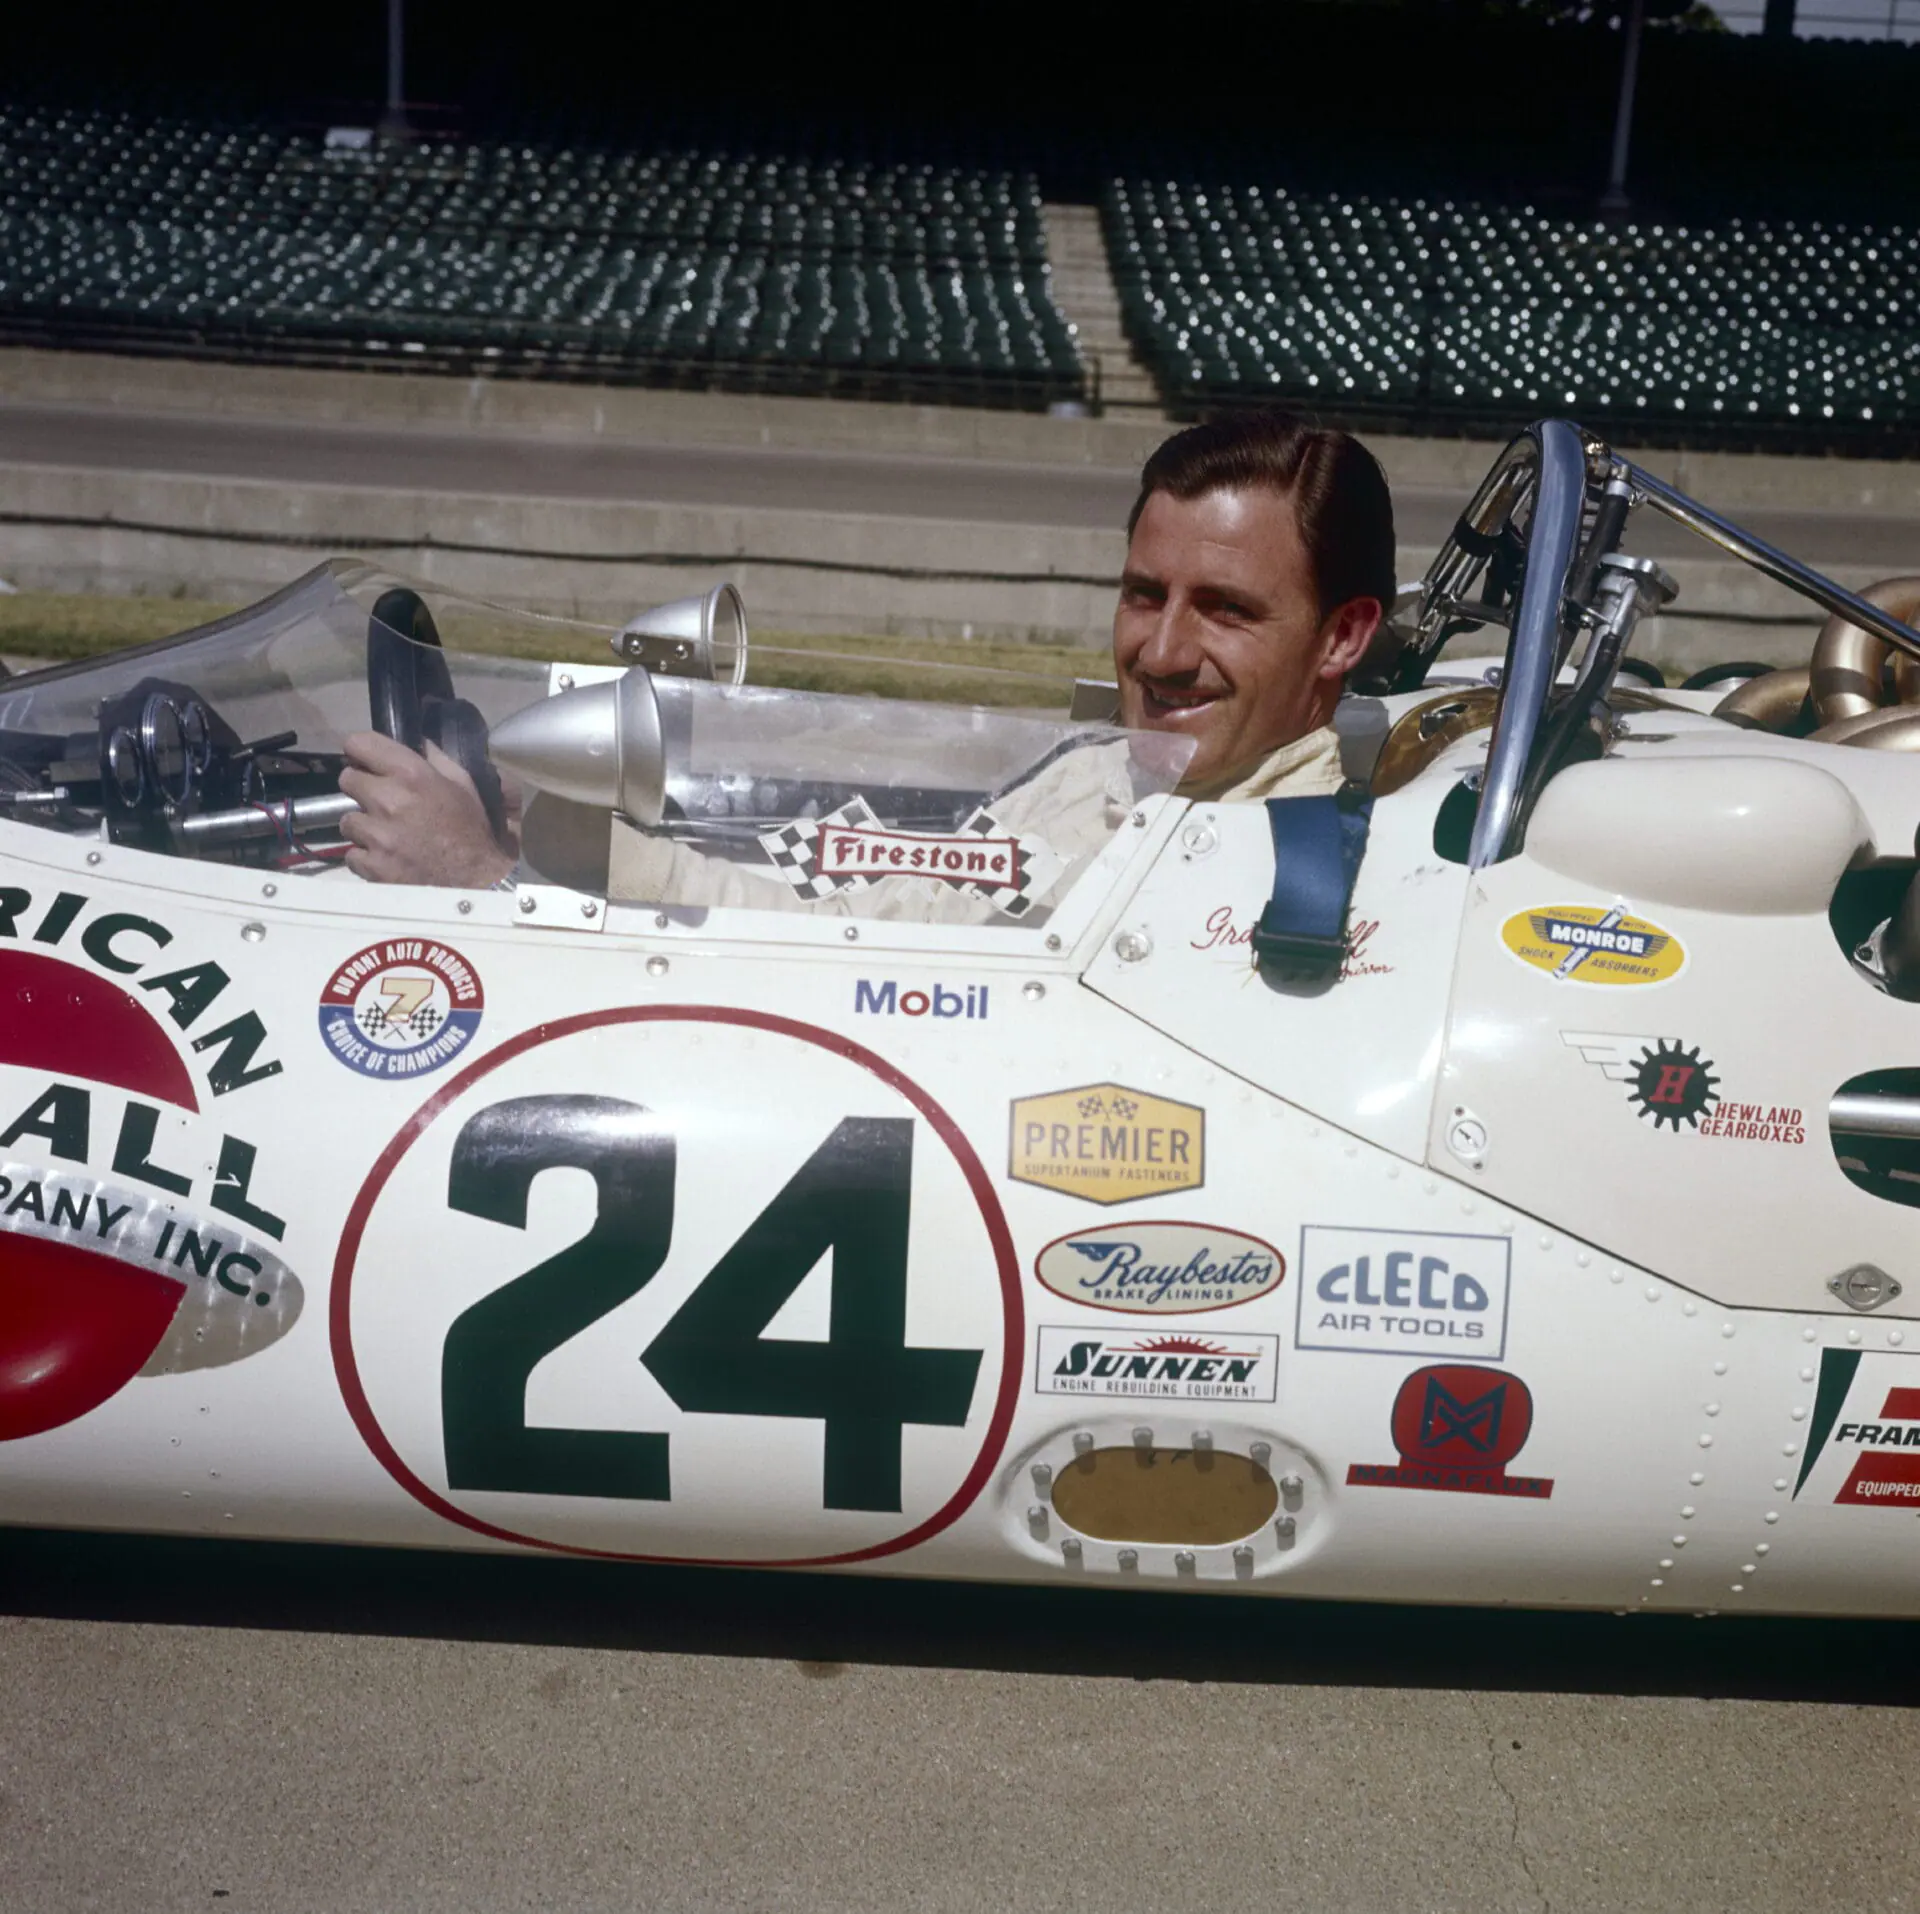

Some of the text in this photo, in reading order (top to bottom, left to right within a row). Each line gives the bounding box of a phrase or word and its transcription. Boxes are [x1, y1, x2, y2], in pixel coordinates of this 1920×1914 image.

[832, 837, 1008, 873] Firestone
[1551, 924, 1645, 953] MONROE
[386, 941, 423, 963] AUTO
[424, 945, 477, 1001] PRODUCTS
[1518, 946, 1659, 978] SHOCK ABSORBERS
[380, 977, 435, 1023] 7
[854, 980, 989, 1019] Mobil
[326, 1019, 467, 1073] CHOICE OF CHAMPIONS
[1649, 1064, 1696, 1104] H
[1700, 1118, 1806, 1145] GEARBOXES
[1714, 1102, 1803, 1126] HEWLAND
[1024, 1121, 1191, 1165] PREMIER
[1024, 1163, 1190, 1182] SUPERTANIUM FASTENERS
[154, 1219, 271, 1307] INC.
[1076, 1242, 1273, 1304] Raybestos
[1316, 1251, 1489, 1312] CLECO
[441, 1093, 985, 1513] 24
[1093, 1287, 1234, 1300] BRAKE LININGS
[1318, 1312, 1485, 1339] AIR TOOLS
[1053, 1341, 1259, 1382] SUNNEN
[1053, 1378, 1257, 1398] ENGINE REBUILDING EQUIPMENT
[1354, 1465, 1542, 1494] MAGNAFLUX
[1855, 1480, 1920, 1498] EQUIPPED
